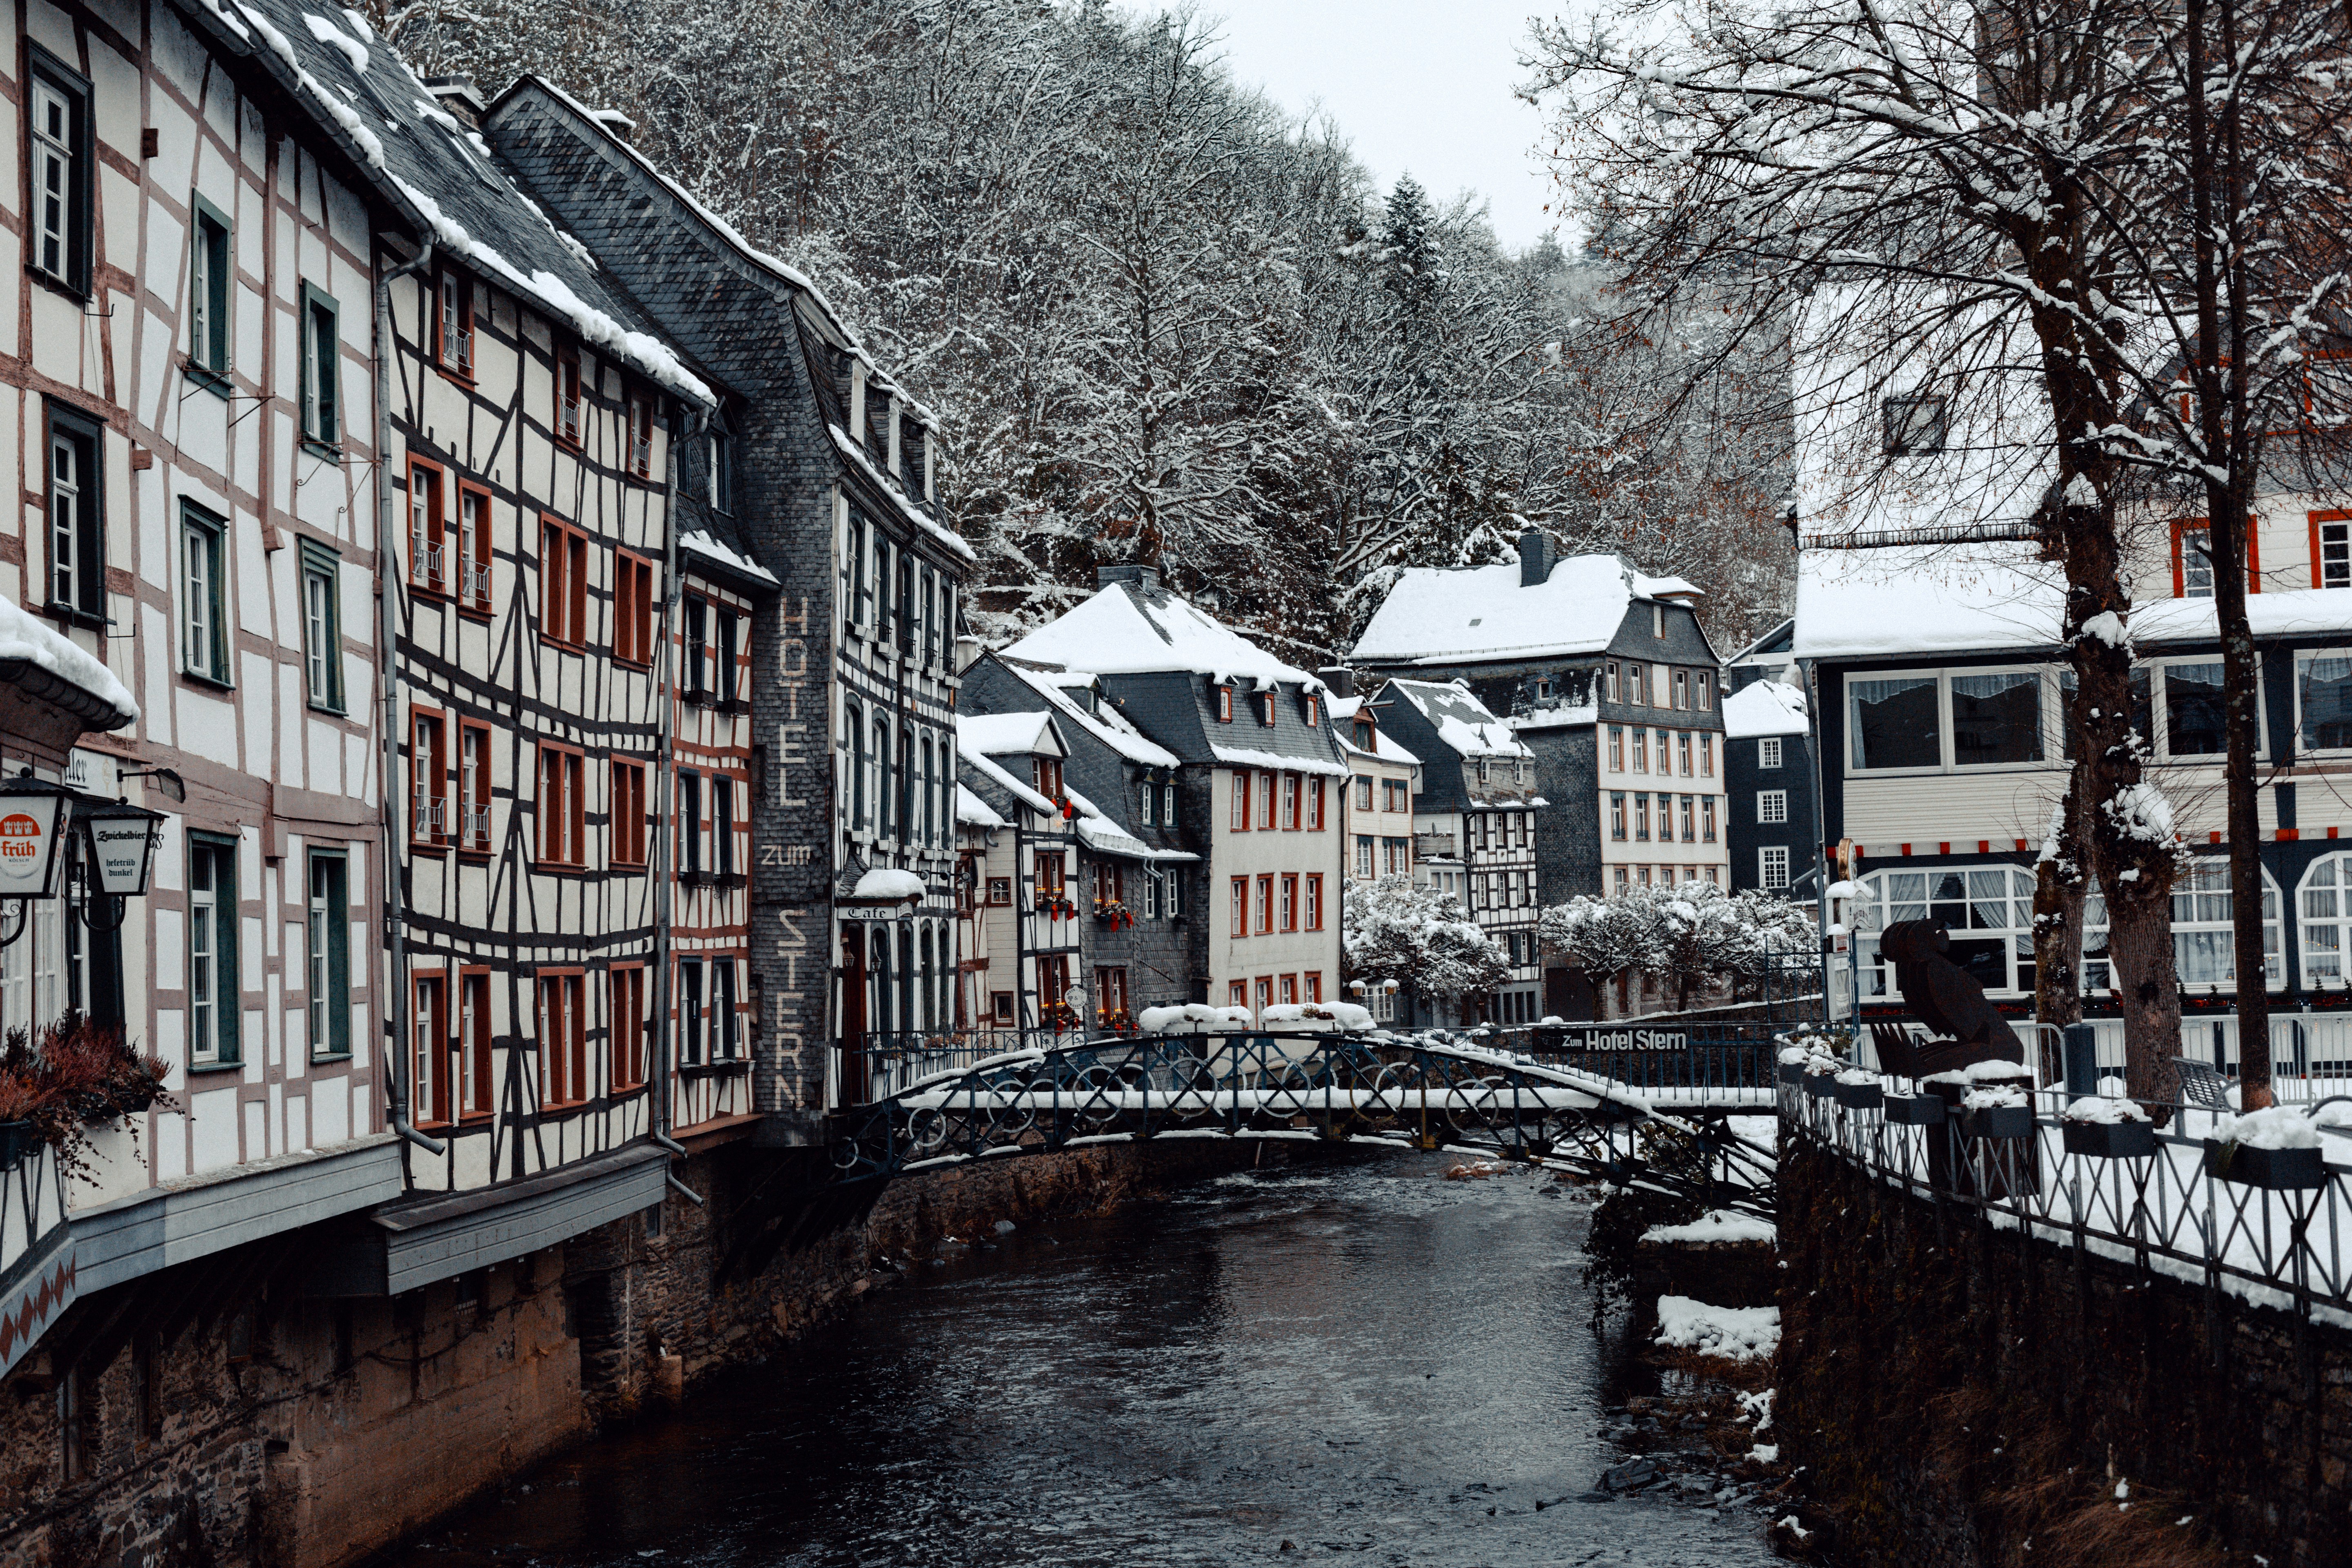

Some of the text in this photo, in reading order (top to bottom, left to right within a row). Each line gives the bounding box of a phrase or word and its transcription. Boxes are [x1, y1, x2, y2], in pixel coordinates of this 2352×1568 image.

[779, 596, 808, 806] HOTEL
[97, 831, 146, 842] Zwickelbier
[106, 859, 136, 868] hefetrüb
[848, 907, 886, 918] Cafe
[776, 909, 807, 1111] STERN
[1561, 1029, 1686, 1050] Zum Hotel Stern
